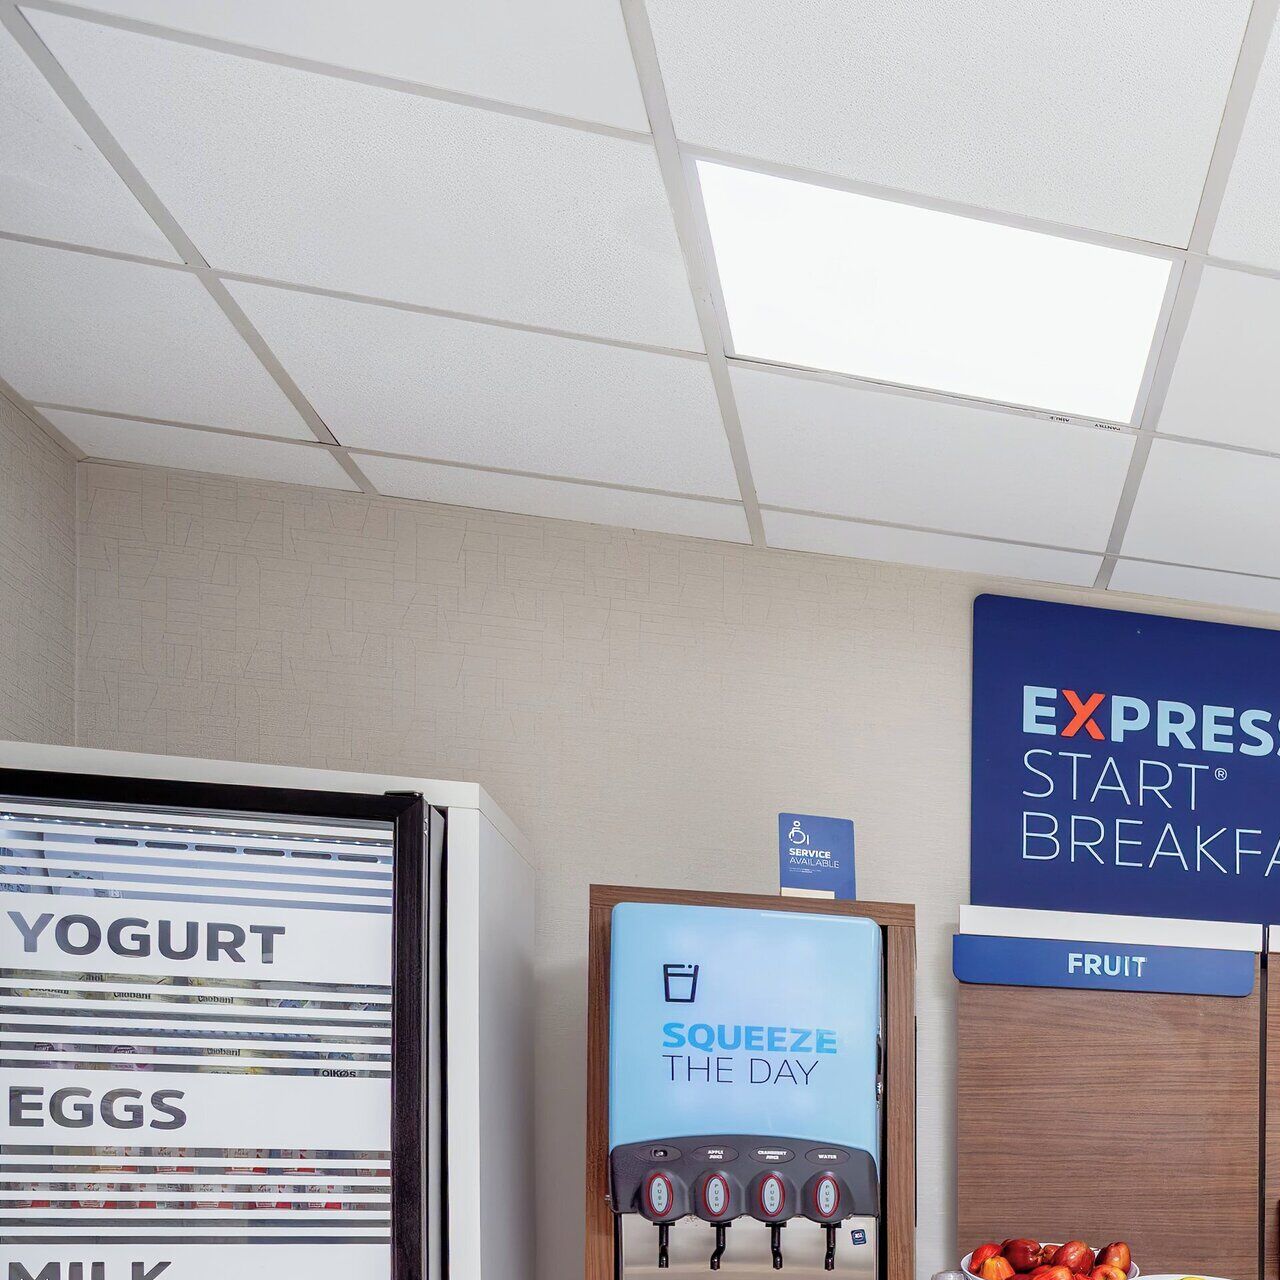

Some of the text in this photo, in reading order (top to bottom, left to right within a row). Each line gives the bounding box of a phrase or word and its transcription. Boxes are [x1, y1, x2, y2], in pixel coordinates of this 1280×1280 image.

[789, 847, 831, 859] SERVICE
[789, 857, 840, 869] AVAILABLE
[7, 911, 286, 965] YOGURT
[1068, 952, 1147, 978] FRUIT
[662, 1022, 838, 1054] SQUEEZE
[662, 1054, 819, 1085] THE DAY
[9, 1086, 187, 1130] EGGS
